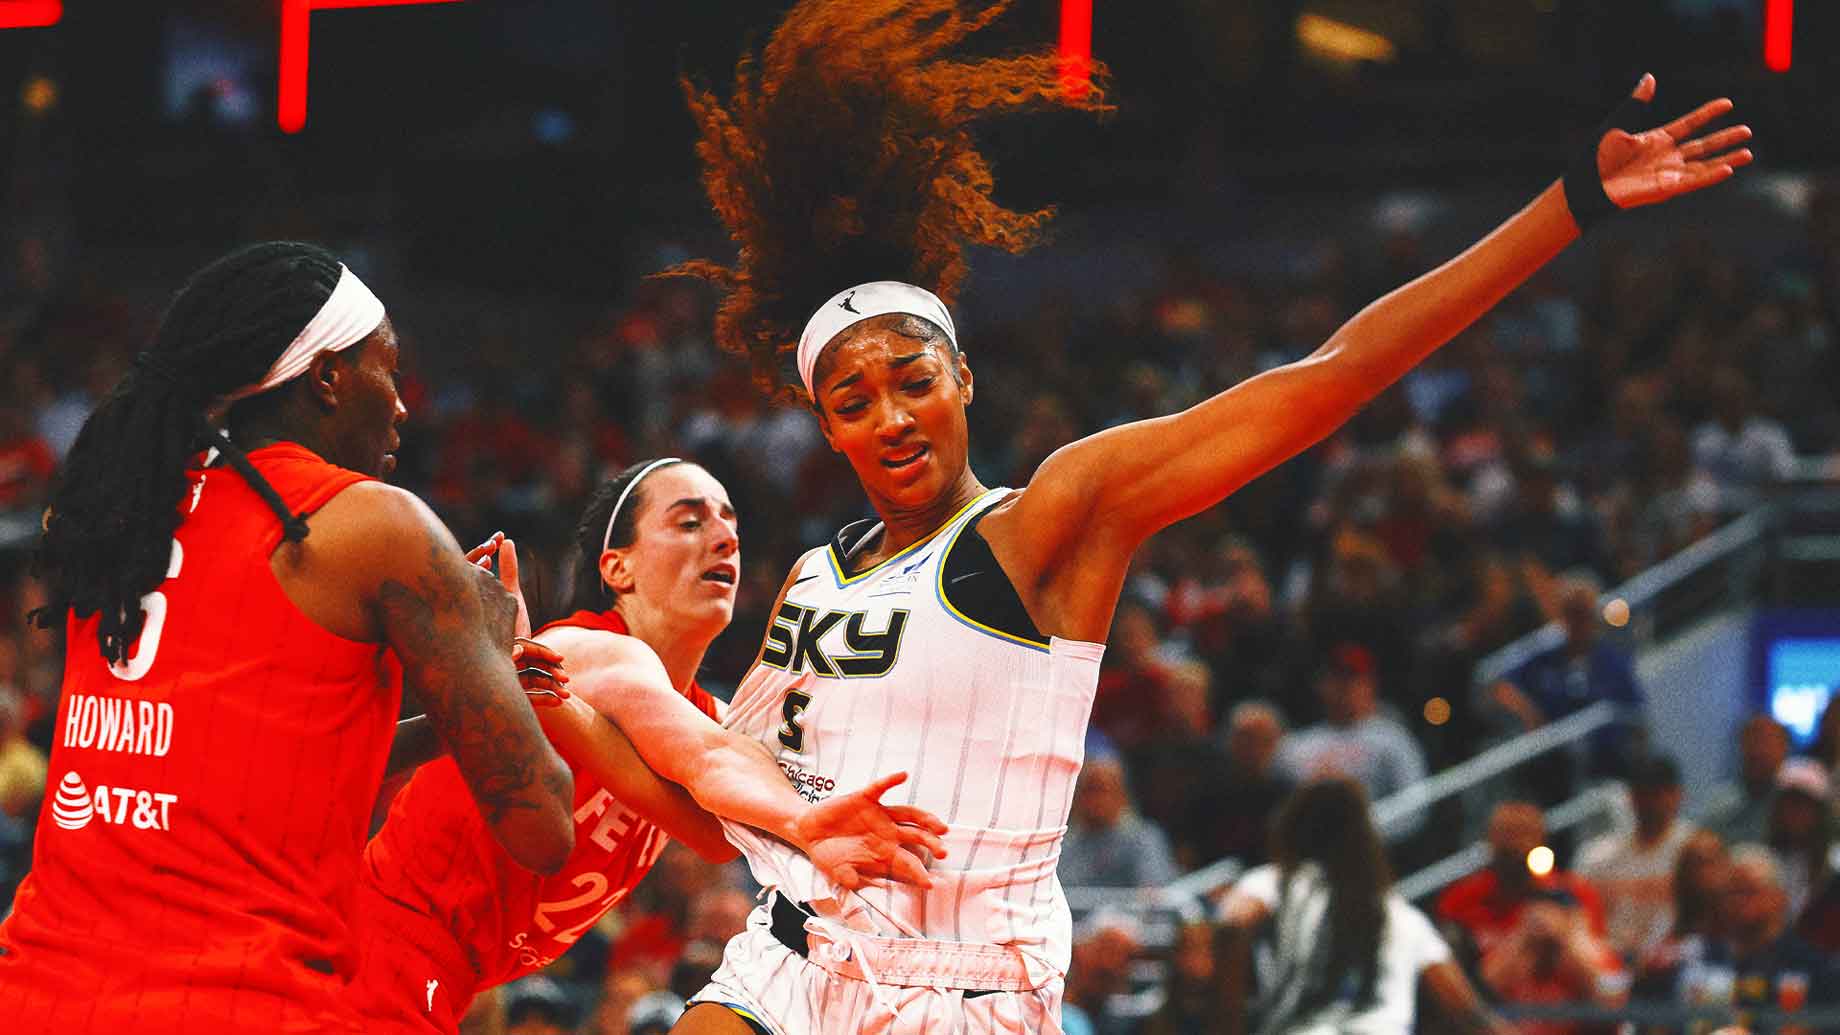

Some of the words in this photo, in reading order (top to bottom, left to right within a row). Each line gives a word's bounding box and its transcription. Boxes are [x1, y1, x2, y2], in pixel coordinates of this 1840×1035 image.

[760, 600, 911, 680] SKY
[63, 694, 174, 757] HOWARD
[93, 785, 178, 831] AT&T
